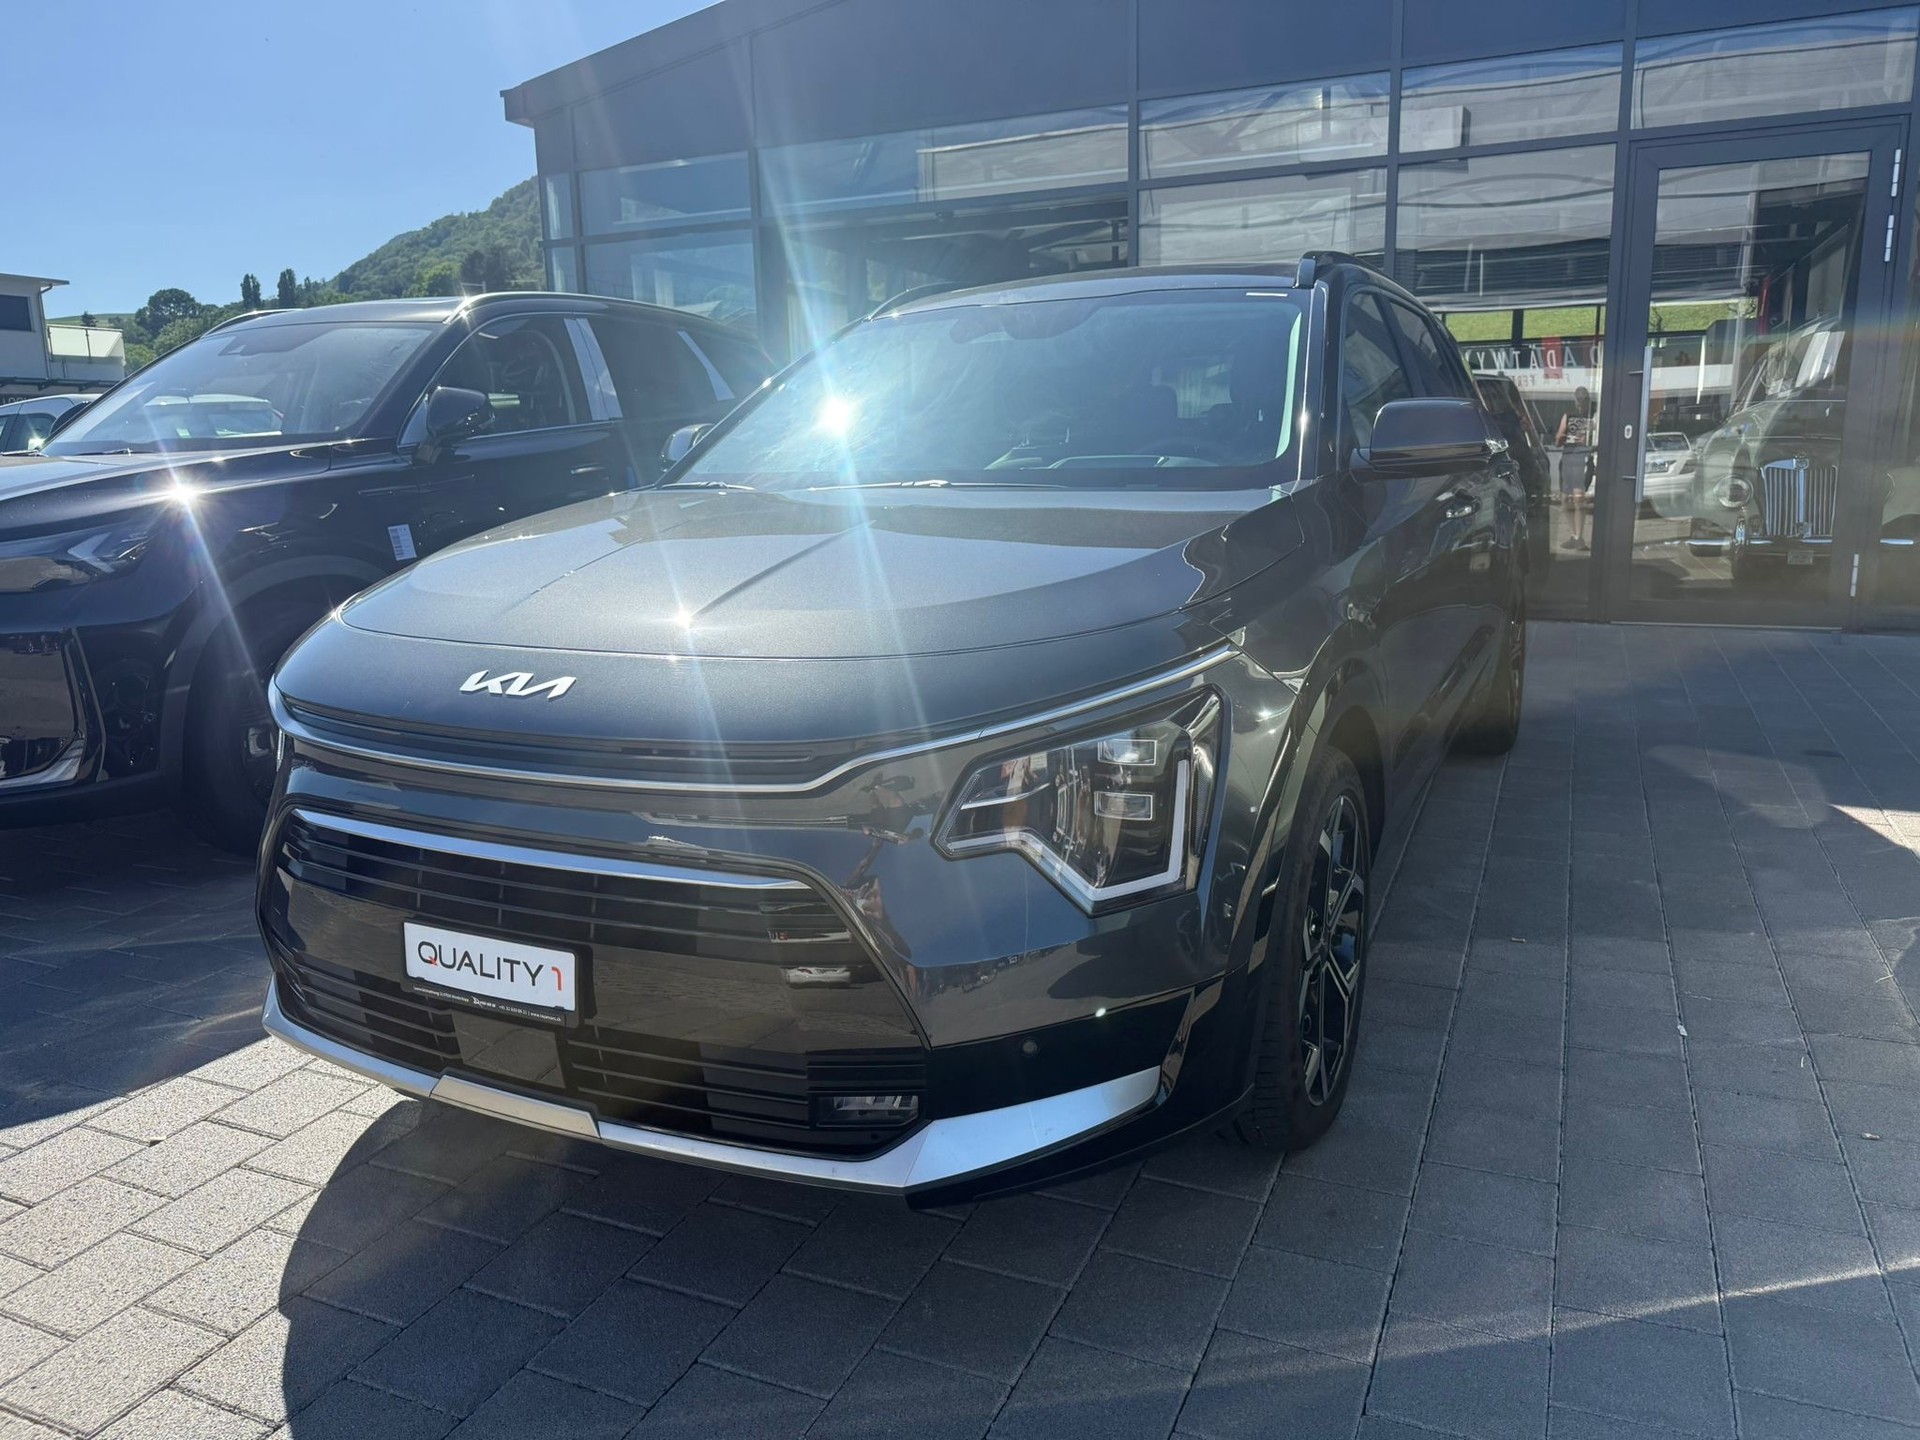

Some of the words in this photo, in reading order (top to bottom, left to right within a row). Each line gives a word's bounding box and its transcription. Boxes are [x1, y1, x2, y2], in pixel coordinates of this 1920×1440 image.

[459, 669, 577, 700] KIA
[417, 940, 545, 987] QUALITY
[551, 965, 563, 991] 1
